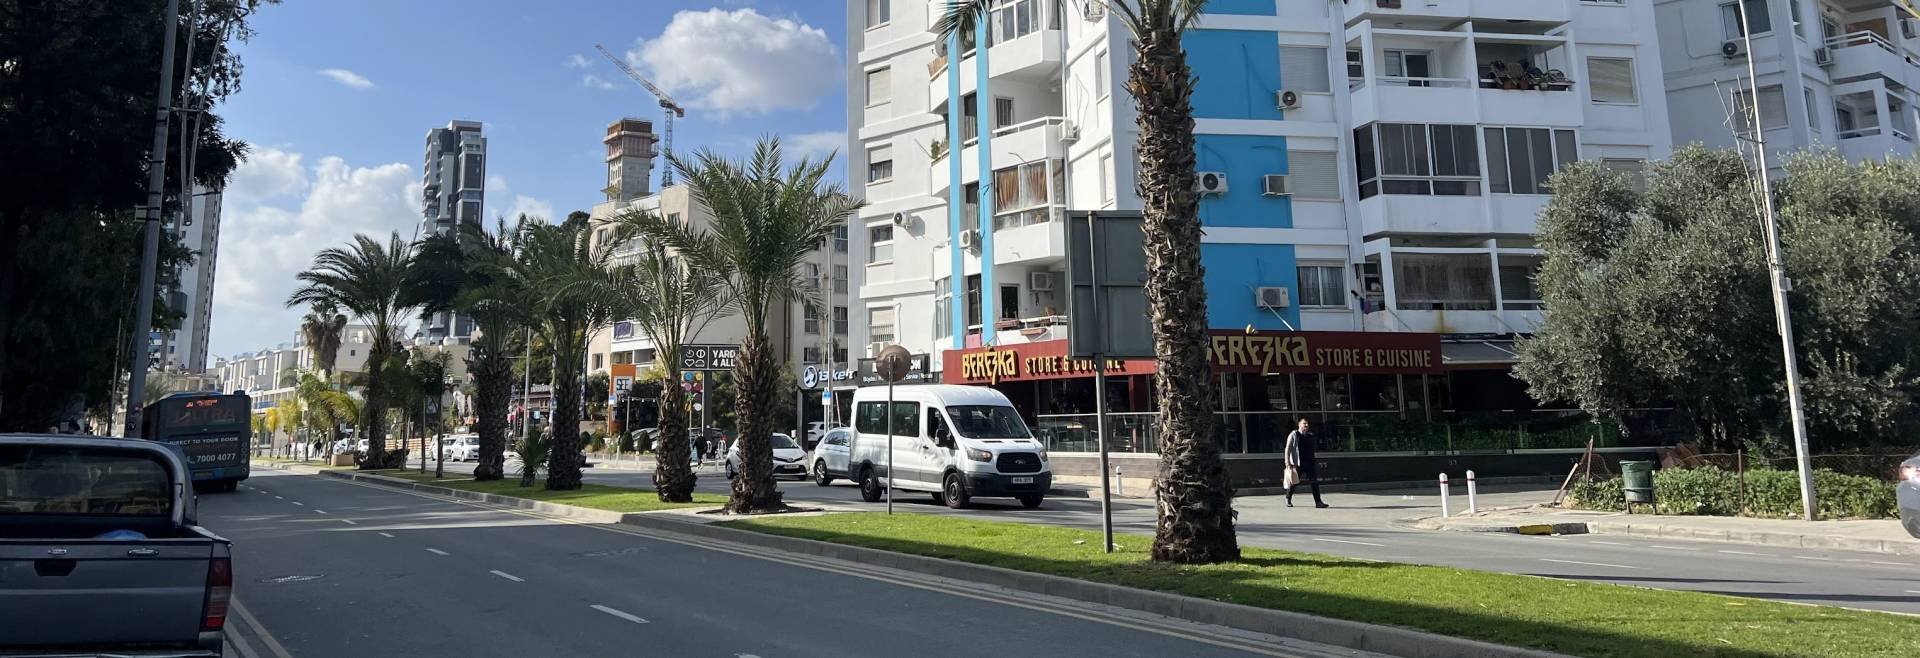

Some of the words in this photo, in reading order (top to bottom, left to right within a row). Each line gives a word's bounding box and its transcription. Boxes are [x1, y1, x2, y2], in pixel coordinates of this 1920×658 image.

[712, 349, 736, 358] YARD
[1206, 335, 1311, 377] EREZKA
[1316, 348, 1358, 367] STORE
[1364, 349, 1373, 367] &
[1377, 349, 1432, 368] CUISINE
[712, 359, 718, 367] 4
[720, 359, 736, 367] ALL
[1025, 357, 1058, 374] STORE
[1074, 359, 1121, 371] CUINE
[196, 454, 216, 463] 7000
[217, 452, 236, 461] 4077
